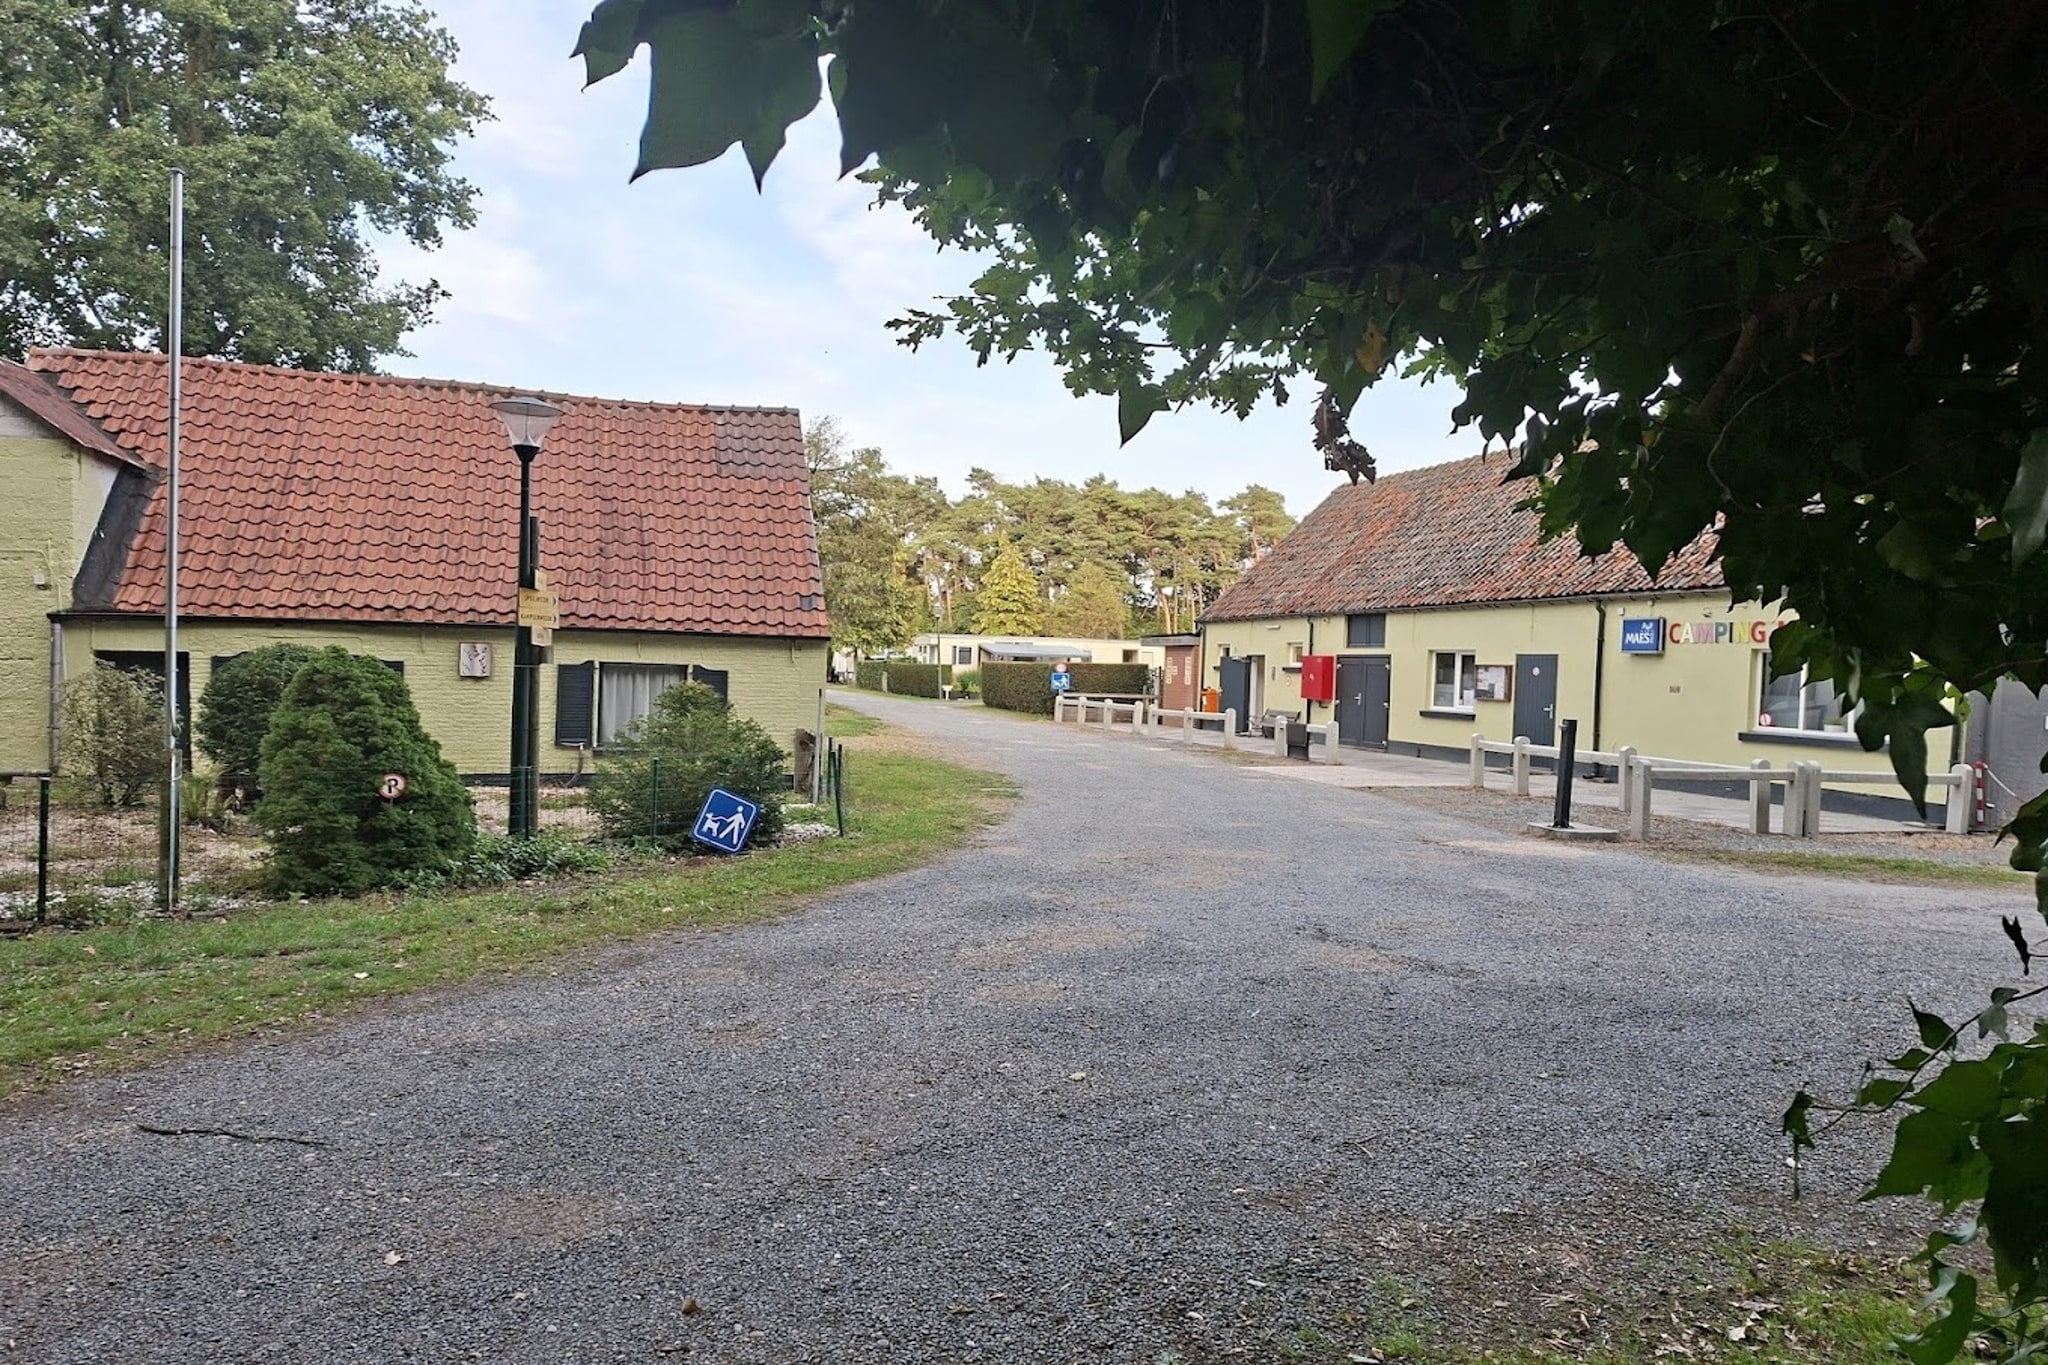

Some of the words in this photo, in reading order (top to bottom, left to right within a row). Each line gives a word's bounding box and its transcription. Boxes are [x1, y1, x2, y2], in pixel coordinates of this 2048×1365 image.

[1625, 633, 1650, 644] MAES
[1669, 621, 1767, 644] CAMPING
[387, 778, 398, 793] P
